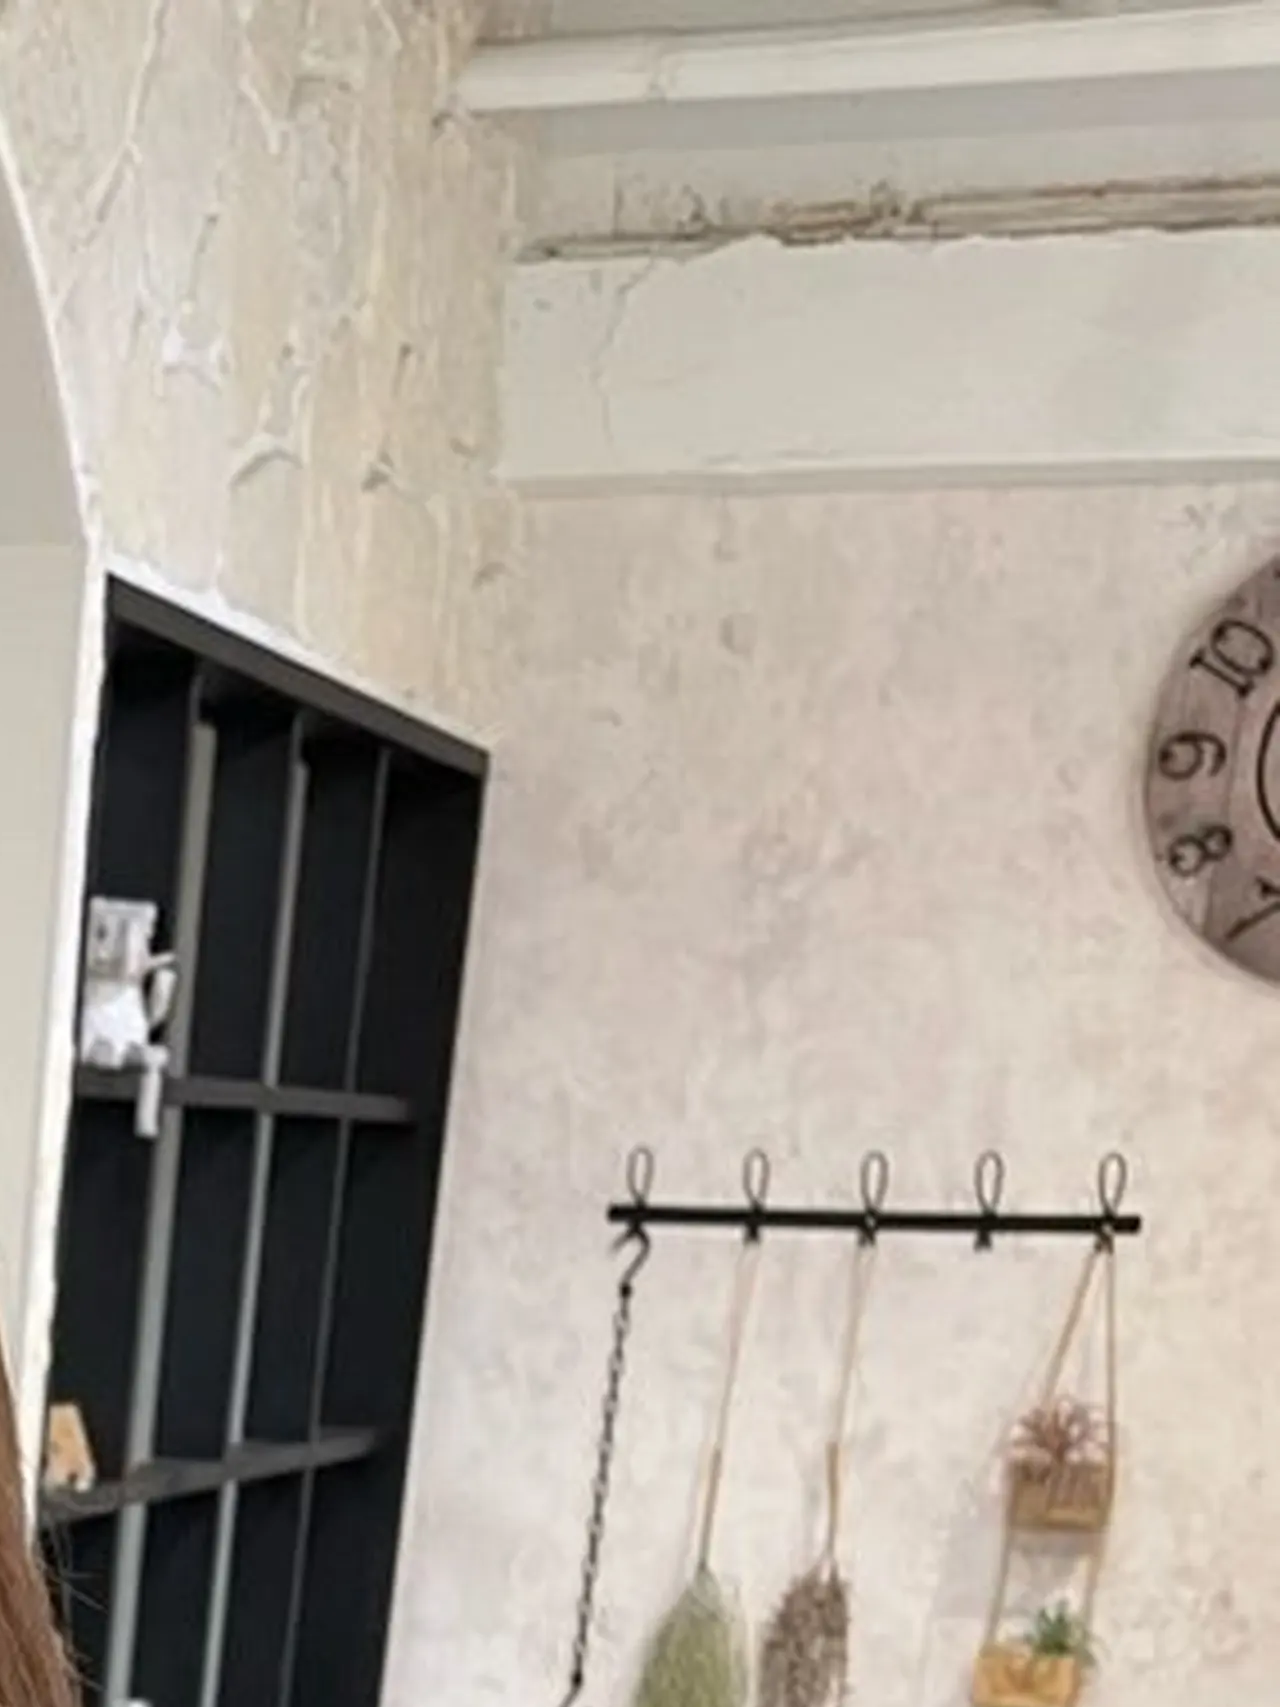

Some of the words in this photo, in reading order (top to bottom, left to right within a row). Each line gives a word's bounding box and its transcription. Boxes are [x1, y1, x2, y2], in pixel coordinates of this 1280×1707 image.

[1189, 618, 1275, 698] 10
[1157, 731, 1227, 781] 9
[1168, 825, 1233, 878] 8
